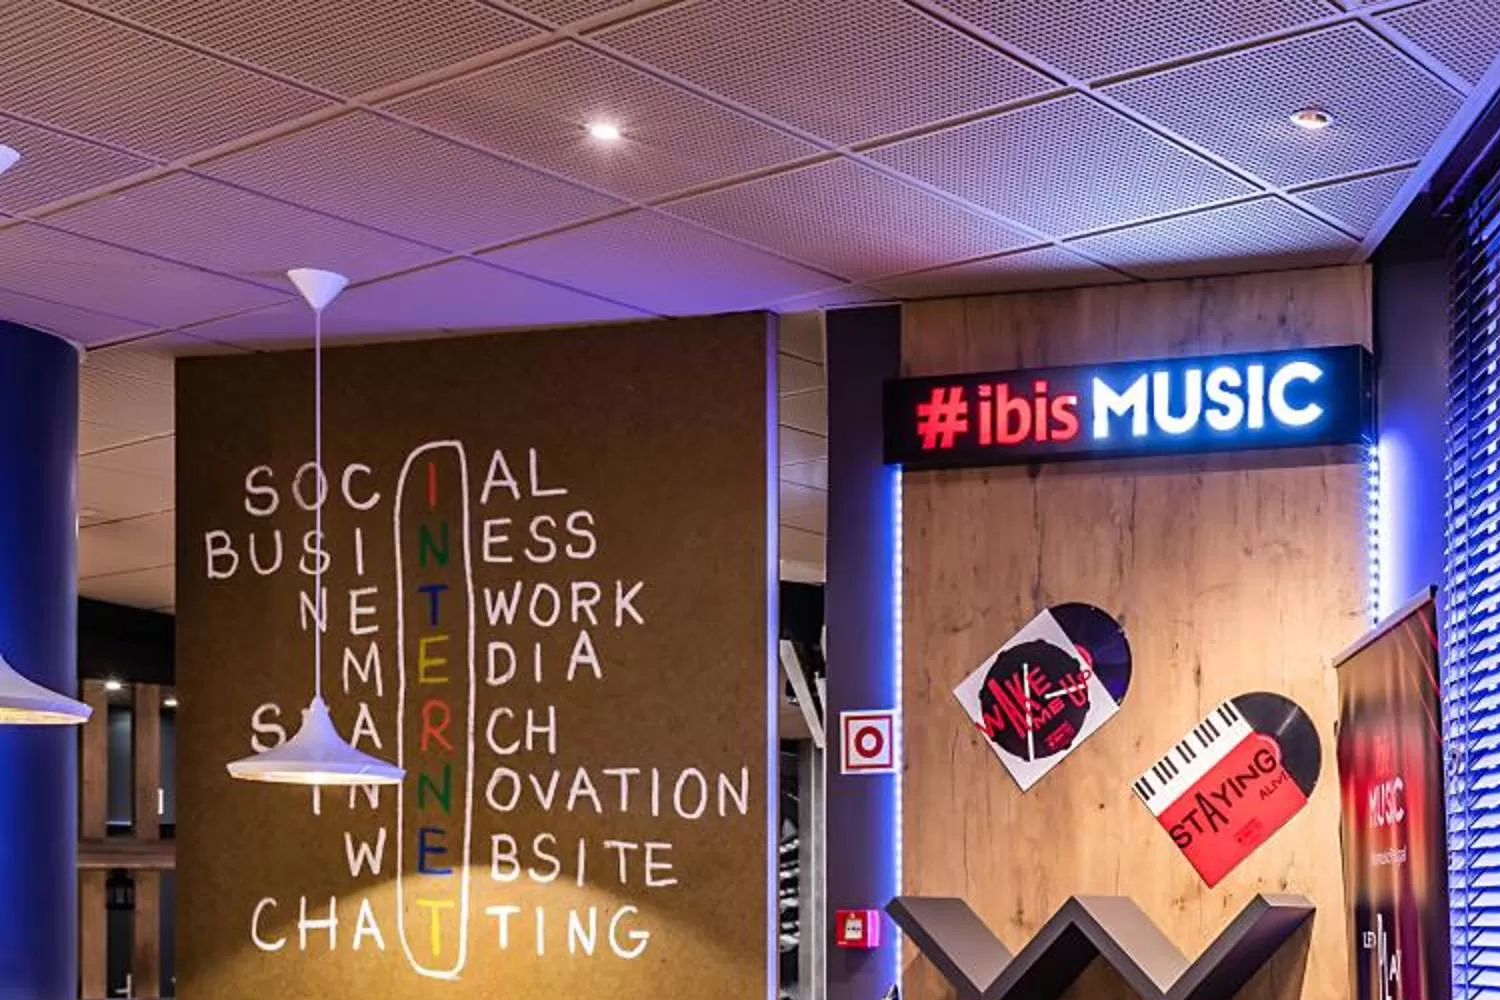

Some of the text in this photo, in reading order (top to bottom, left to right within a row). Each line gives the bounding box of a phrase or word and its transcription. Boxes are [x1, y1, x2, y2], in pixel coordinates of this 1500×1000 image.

[916, 361, 1325, 449] #ibis MUSIC
[1168, 748, 1277, 850] STAYING
